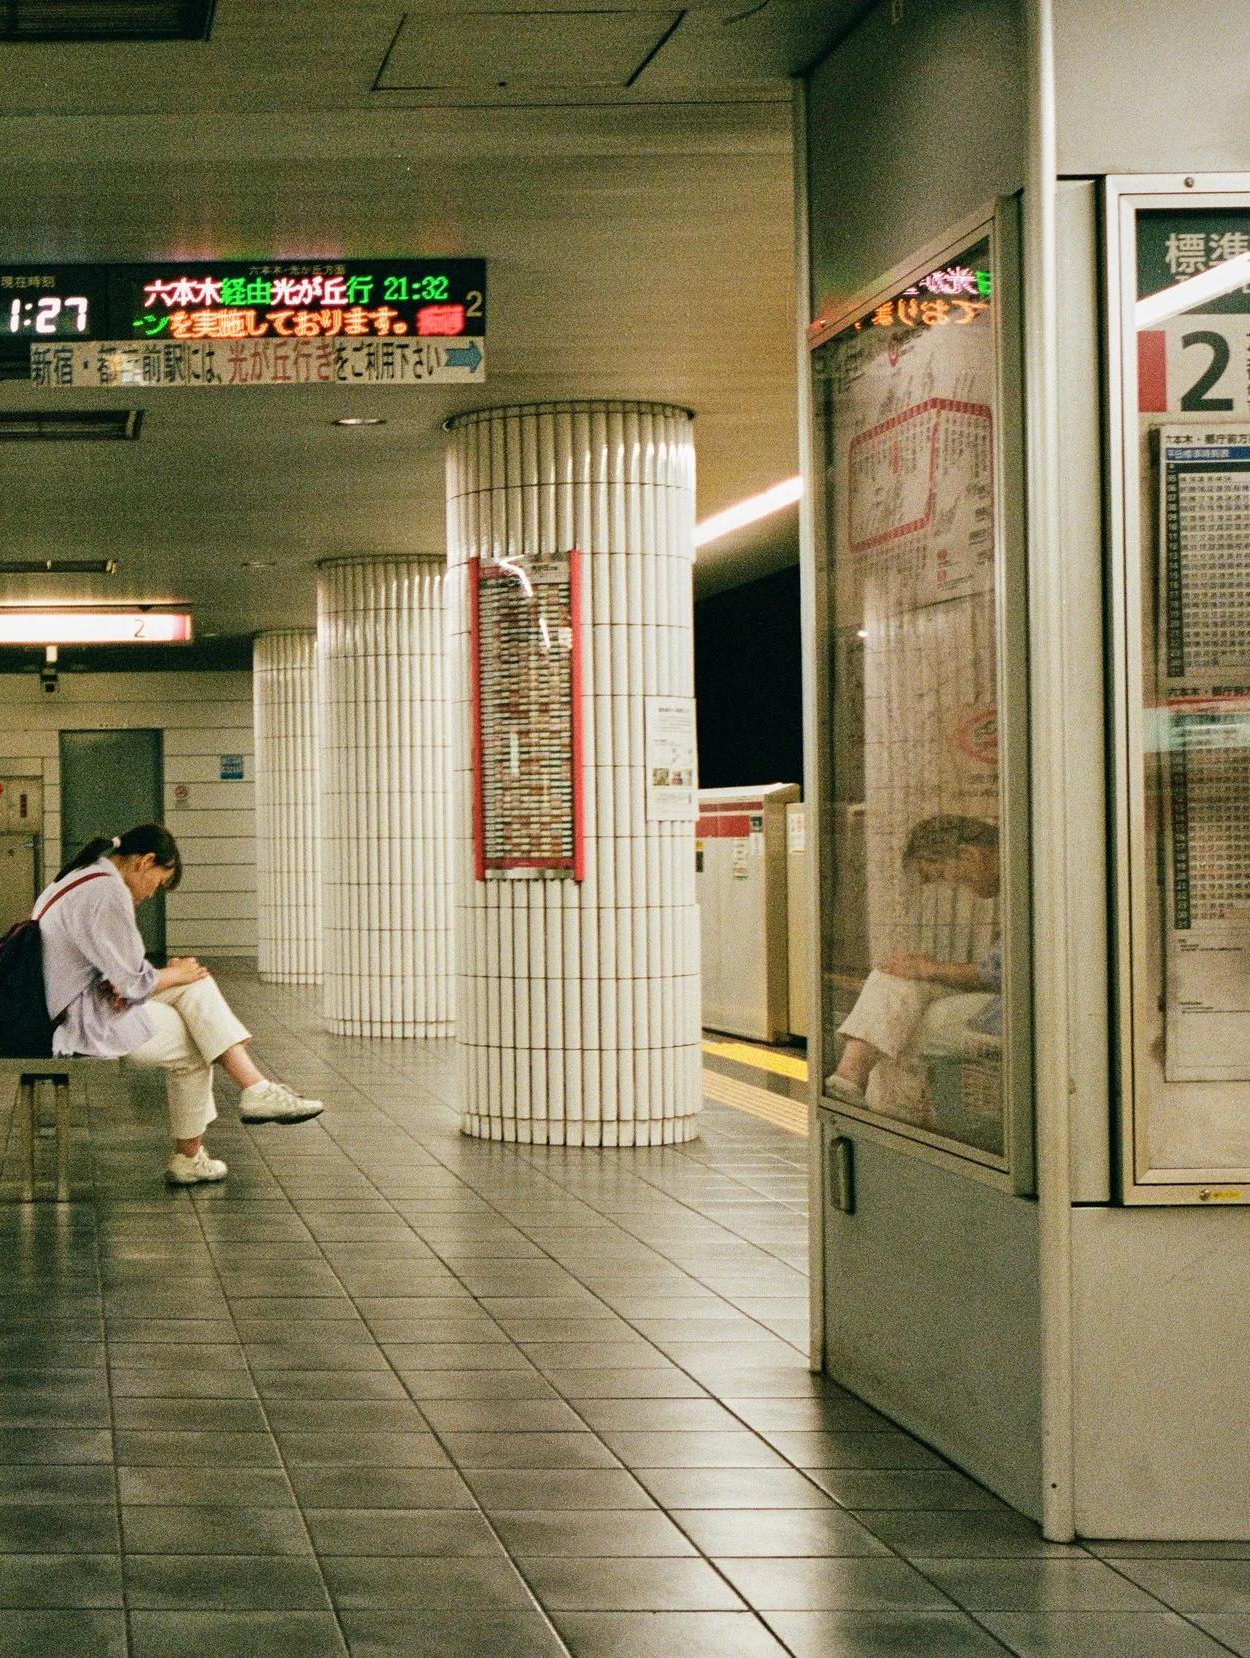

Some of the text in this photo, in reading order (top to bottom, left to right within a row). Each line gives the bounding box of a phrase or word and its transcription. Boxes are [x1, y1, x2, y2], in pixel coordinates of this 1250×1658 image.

[144, 275, 449, 307] 六本木経由光が丘行 21:32
[466, 290, 484, 317] 2
[1179, 330, 1234, 412] 2
[133, 618, 146, 638] 2
